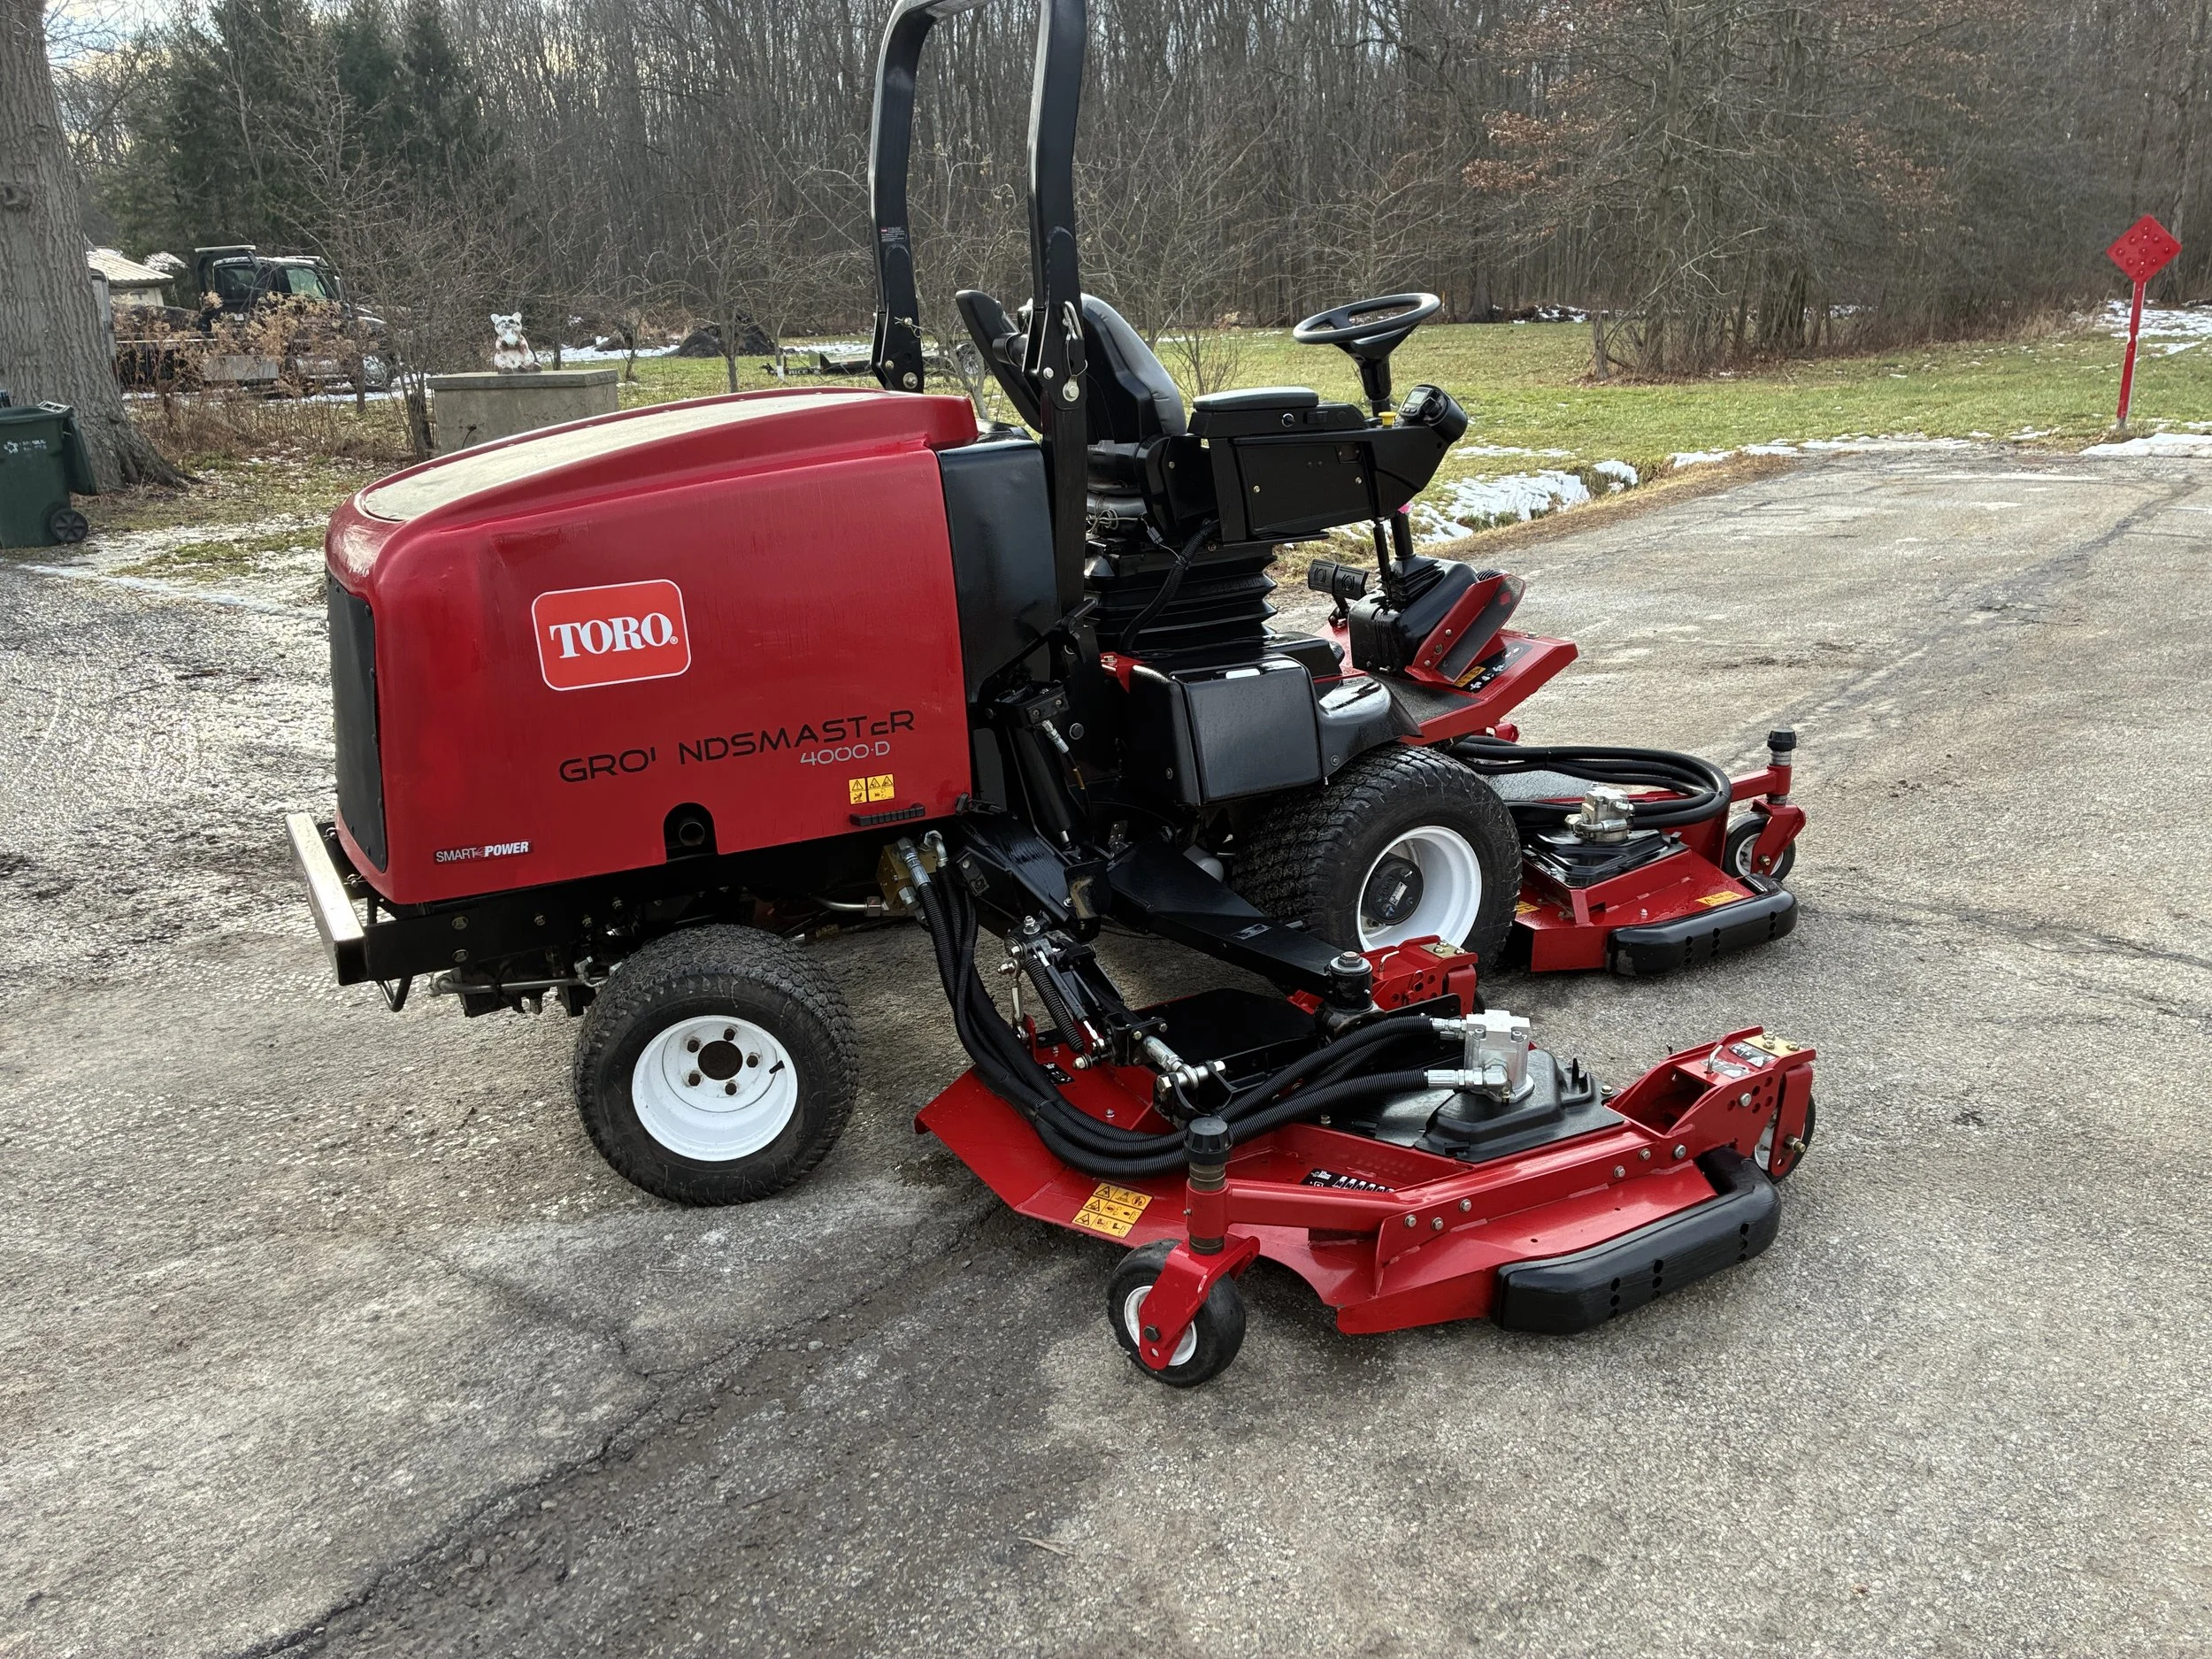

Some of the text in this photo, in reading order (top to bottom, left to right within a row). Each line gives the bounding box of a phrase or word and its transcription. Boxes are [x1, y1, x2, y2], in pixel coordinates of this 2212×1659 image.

[549, 612, 675, 658] TORO
[436, 841, 530, 863] SMART POWER
